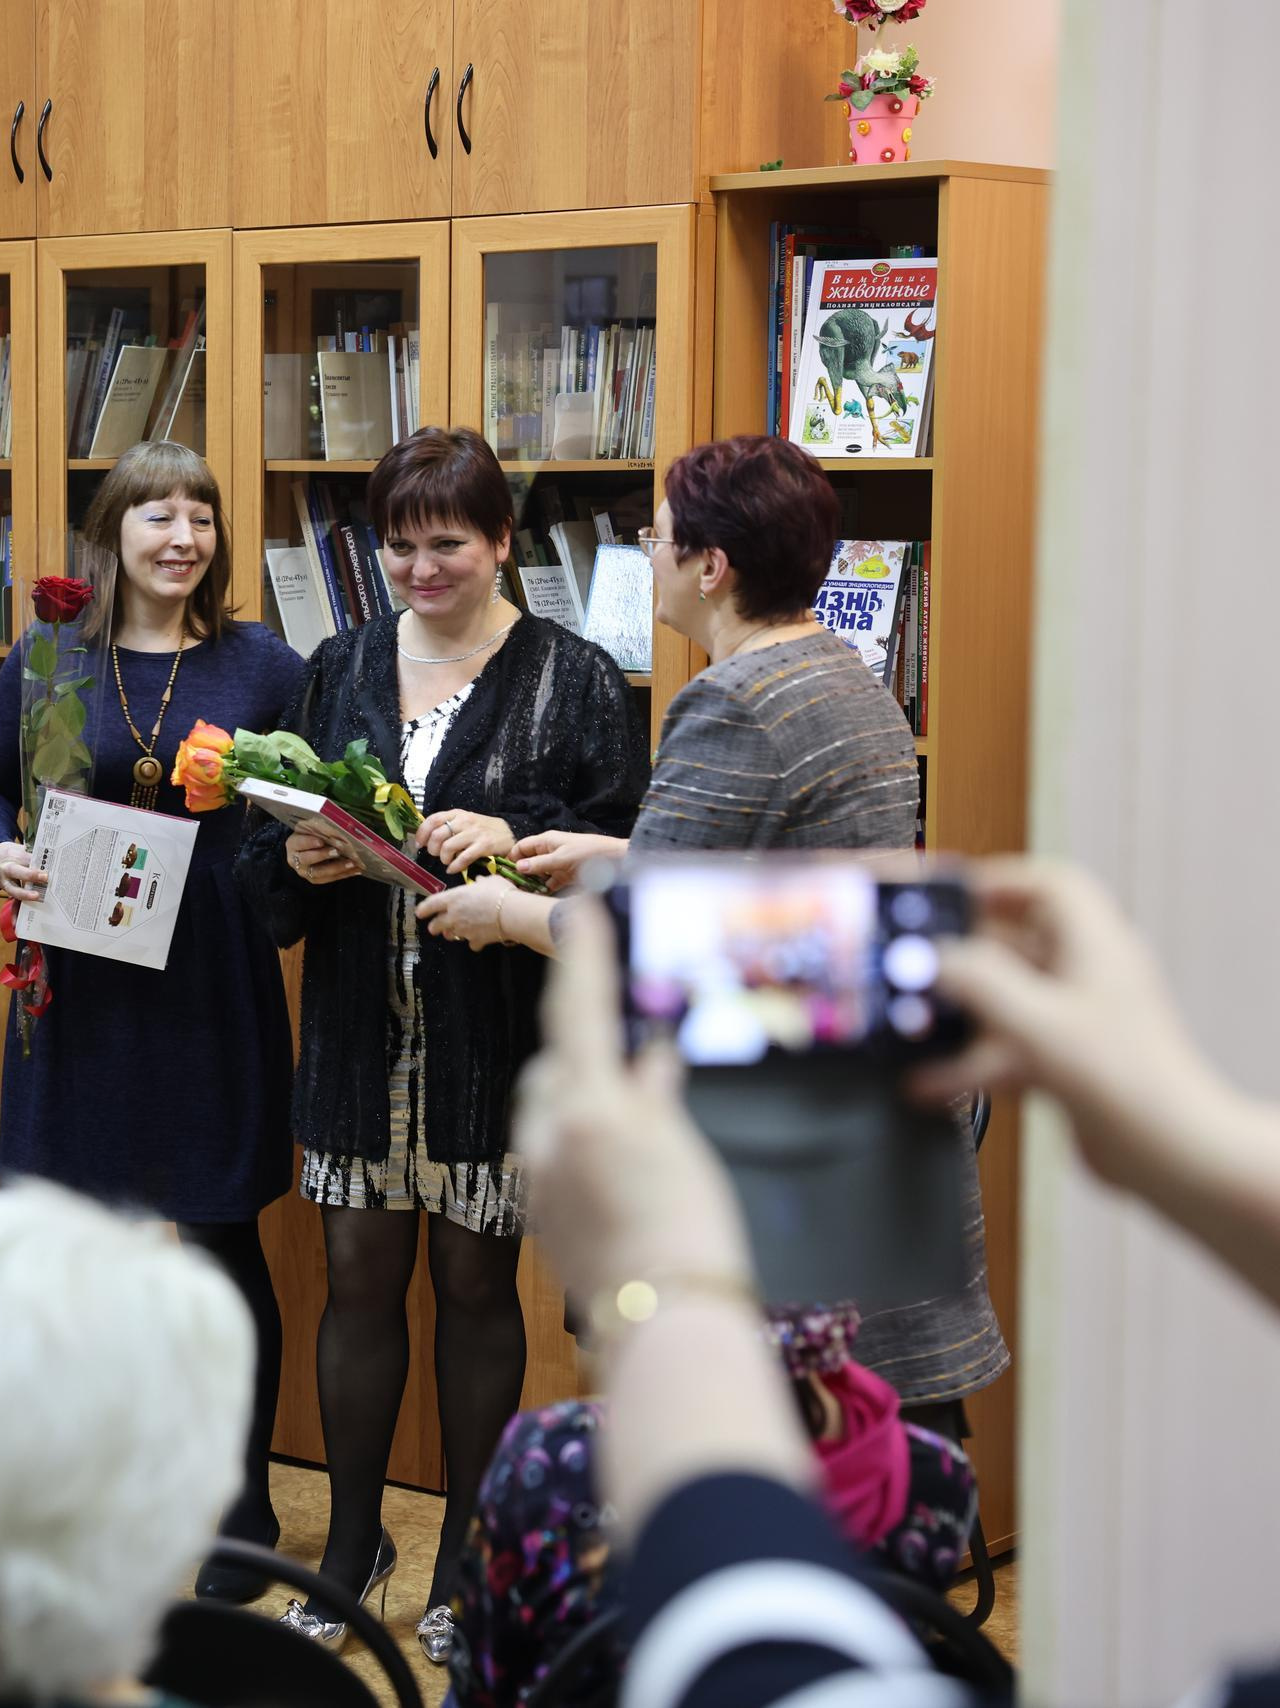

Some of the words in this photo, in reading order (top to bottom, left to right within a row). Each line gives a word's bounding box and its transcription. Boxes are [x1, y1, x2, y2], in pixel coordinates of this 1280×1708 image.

[832, 274, 926, 285] Вымершие
[827, 283, 930, 299] животные
[346, 532, 363, 584] ОРУЖЕЙНОГО
[357, 583, 371, 620] УЛЬСКОГО
[813, 590, 883, 612] изнь
[814, 610, 874, 632] еана
